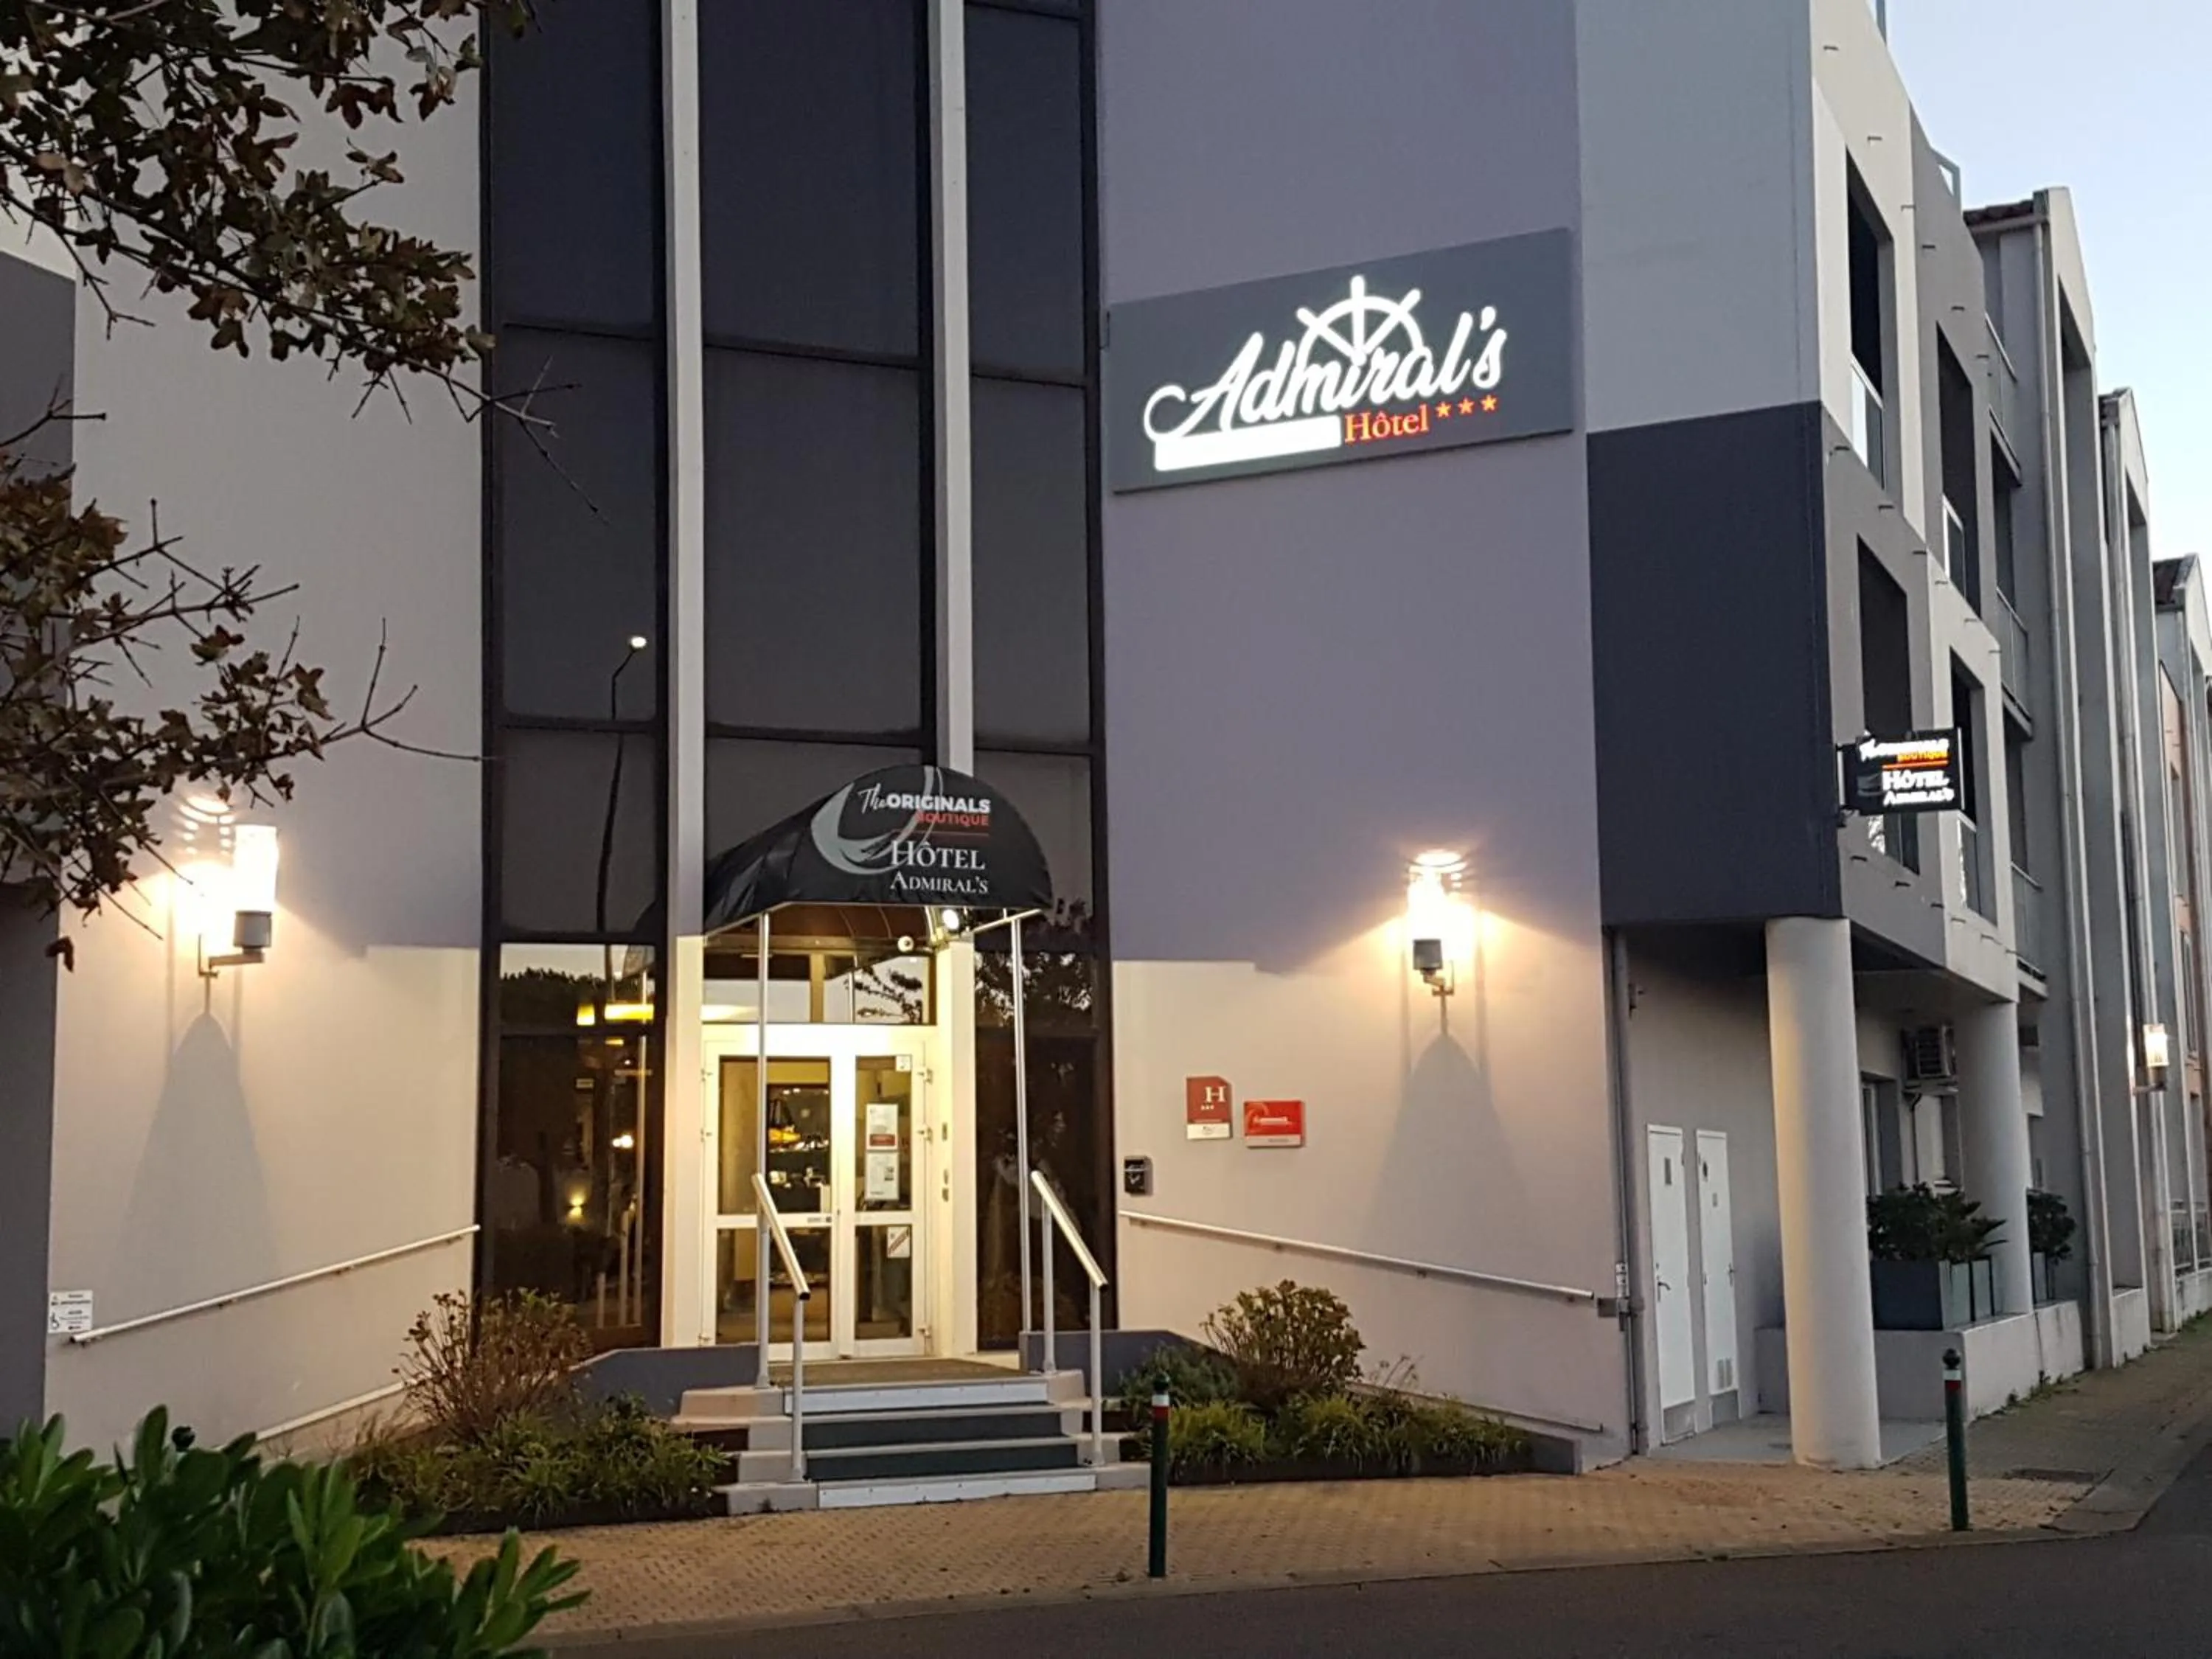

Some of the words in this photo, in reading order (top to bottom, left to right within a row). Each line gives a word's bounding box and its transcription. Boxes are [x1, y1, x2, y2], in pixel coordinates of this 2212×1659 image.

[1144, 306, 1508, 441] Admiral's
[1344, 405, 1428, 442] Hôtel
[886, 793, 991, 813] ORIGINALS
[917, 812, 989, 827] BOUTIQUE
[890, 840, 986, 870] HÔTEL
[890, 871, 989, 894] ADMIRAL'S
[1204, 1086, 1226, 1103] H
